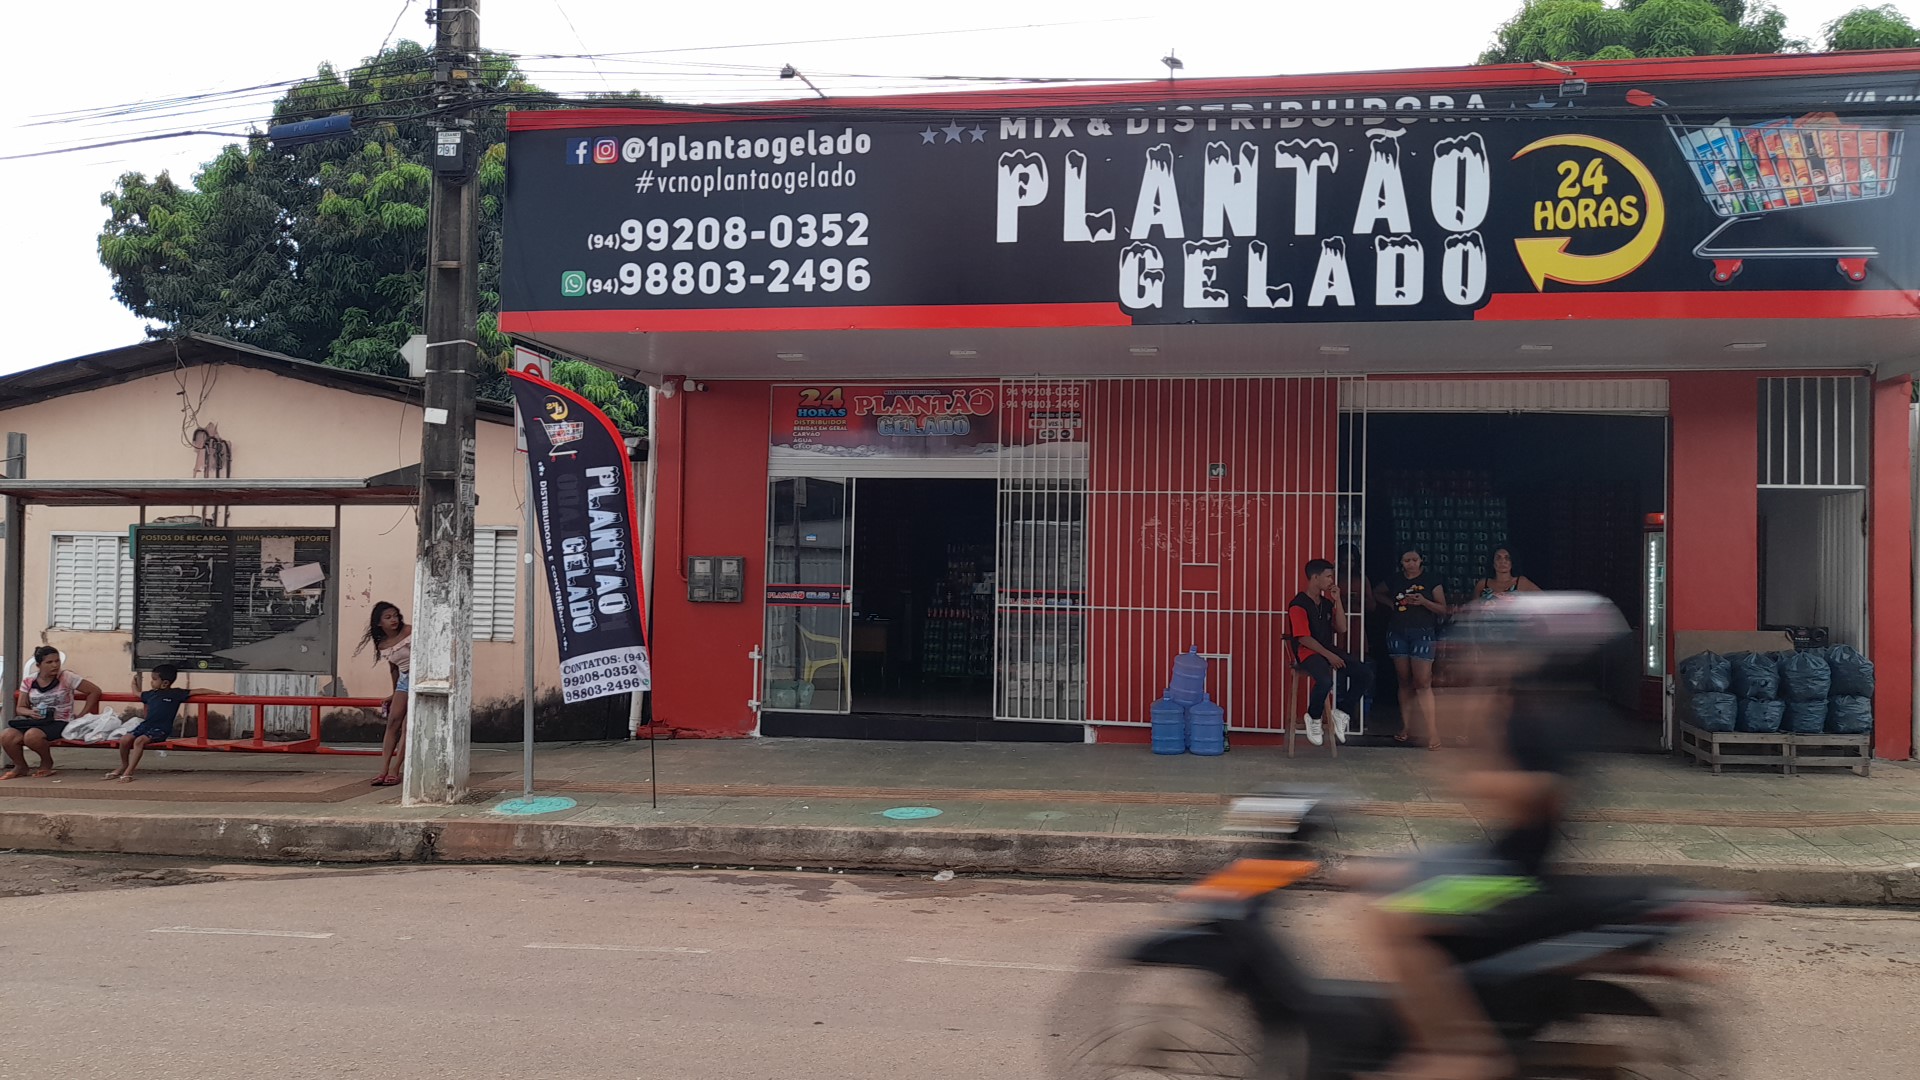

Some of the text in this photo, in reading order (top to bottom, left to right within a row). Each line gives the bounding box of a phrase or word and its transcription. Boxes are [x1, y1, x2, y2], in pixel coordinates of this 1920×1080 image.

[1000, 117, 1075, 139] MIX
[1086, 117, 1113, 136] &
[621, 128, 872, 168] @1plantaogelado
[635, 160, 857, 198] #vcnoplantaogelado
[996, 126, 1491, 243] PLANTÃO
[1556, 158, 1608, 198] 24
[1533, 194, 1640, 231] HORAS
[1118, 230, 1487, 308] GELADO
[799, 387, 845, 409] 24
[854, 388, 995, 416] PLANTÃO
[1006, 387, 1080, 397] 94 99208-0352
[1006, 400, 1018, 409] 94
[797, 408, 847, 417] HORAS
[877, 415, 970, 436] GELADO
[540, 480, 553, 553] DISTRIBUIDORA
[562, 535, 598, 633] GELADO
[563, 651, 647, 675] CONTATOS: (94)
[563, 664, 638, 688] 99208-0352
[565, 677, 640, 702] 98803-2496
